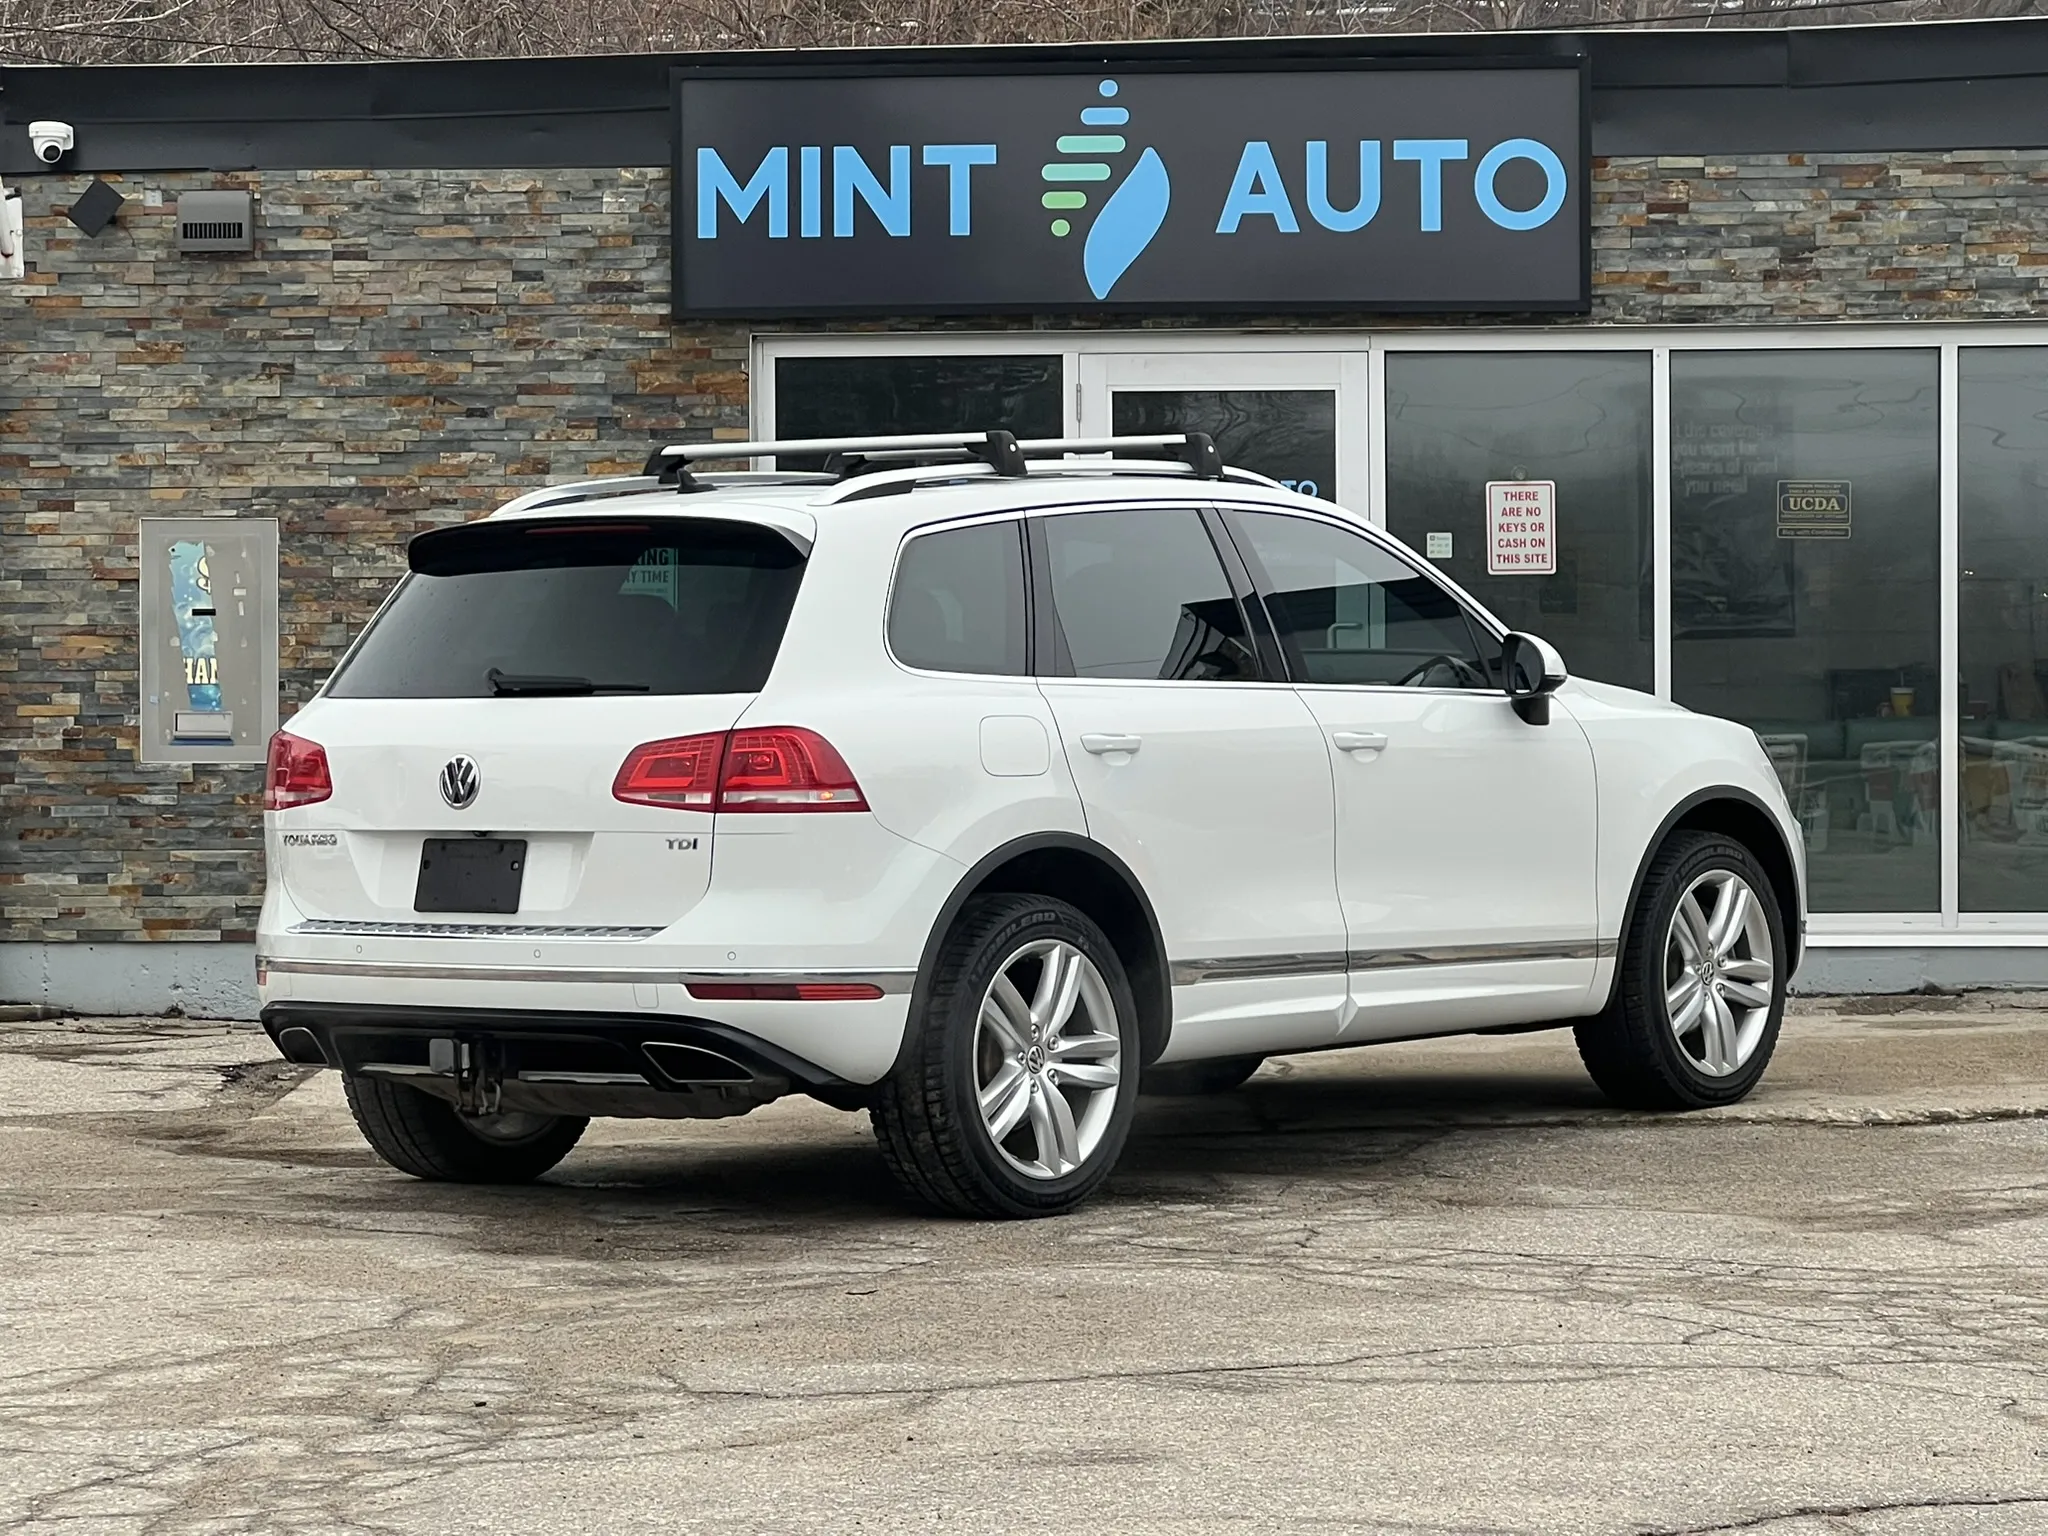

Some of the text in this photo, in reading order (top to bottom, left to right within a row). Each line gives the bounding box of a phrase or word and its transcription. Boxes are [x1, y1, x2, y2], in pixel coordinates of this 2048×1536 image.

[697, 138, 1568, 239] MINT AUTO
[1503, 491, 1539, 501] THERE
[1789, 497, 1840, 510] UCDA
[1501, 507, 1541, 517] ARE NO
[1498, 522, 1545, 533] KEYS OR
[1498, 538, 1545, 548] CASH ON
[636, 549, 669, 566] ING
[1496, 553, 1548, 564] THIS SITE
[640, 570, 669, 584] TIME
[665, 838, 698, 850] TDI
